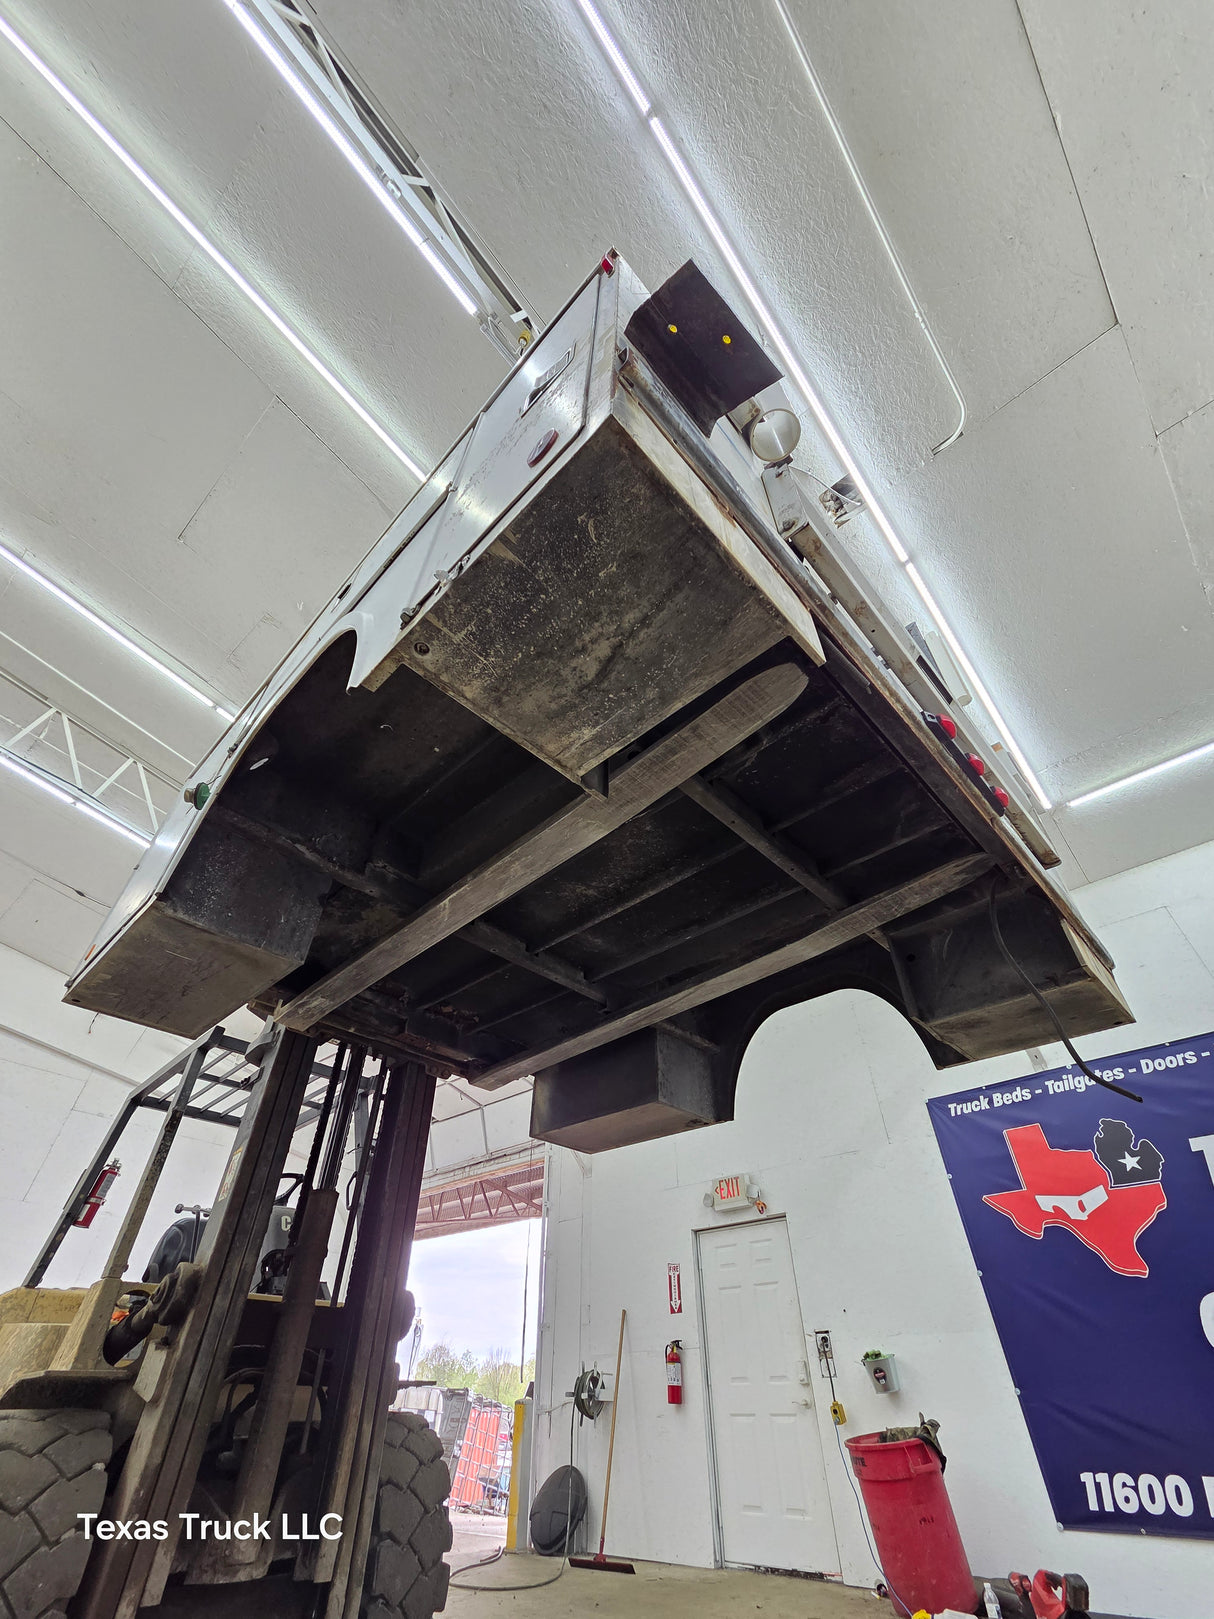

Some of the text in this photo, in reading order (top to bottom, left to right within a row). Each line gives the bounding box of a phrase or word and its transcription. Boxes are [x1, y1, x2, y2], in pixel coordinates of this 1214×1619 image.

[948, 1095, 990, 1117] Truck
[992, 1087, 1032, 1107] Beds
[1140, 1051, 1198, 1074] Doors
[719, 1176, 740, 1200] EXIT
[1080, 1472, 1194, 1517] 11600
